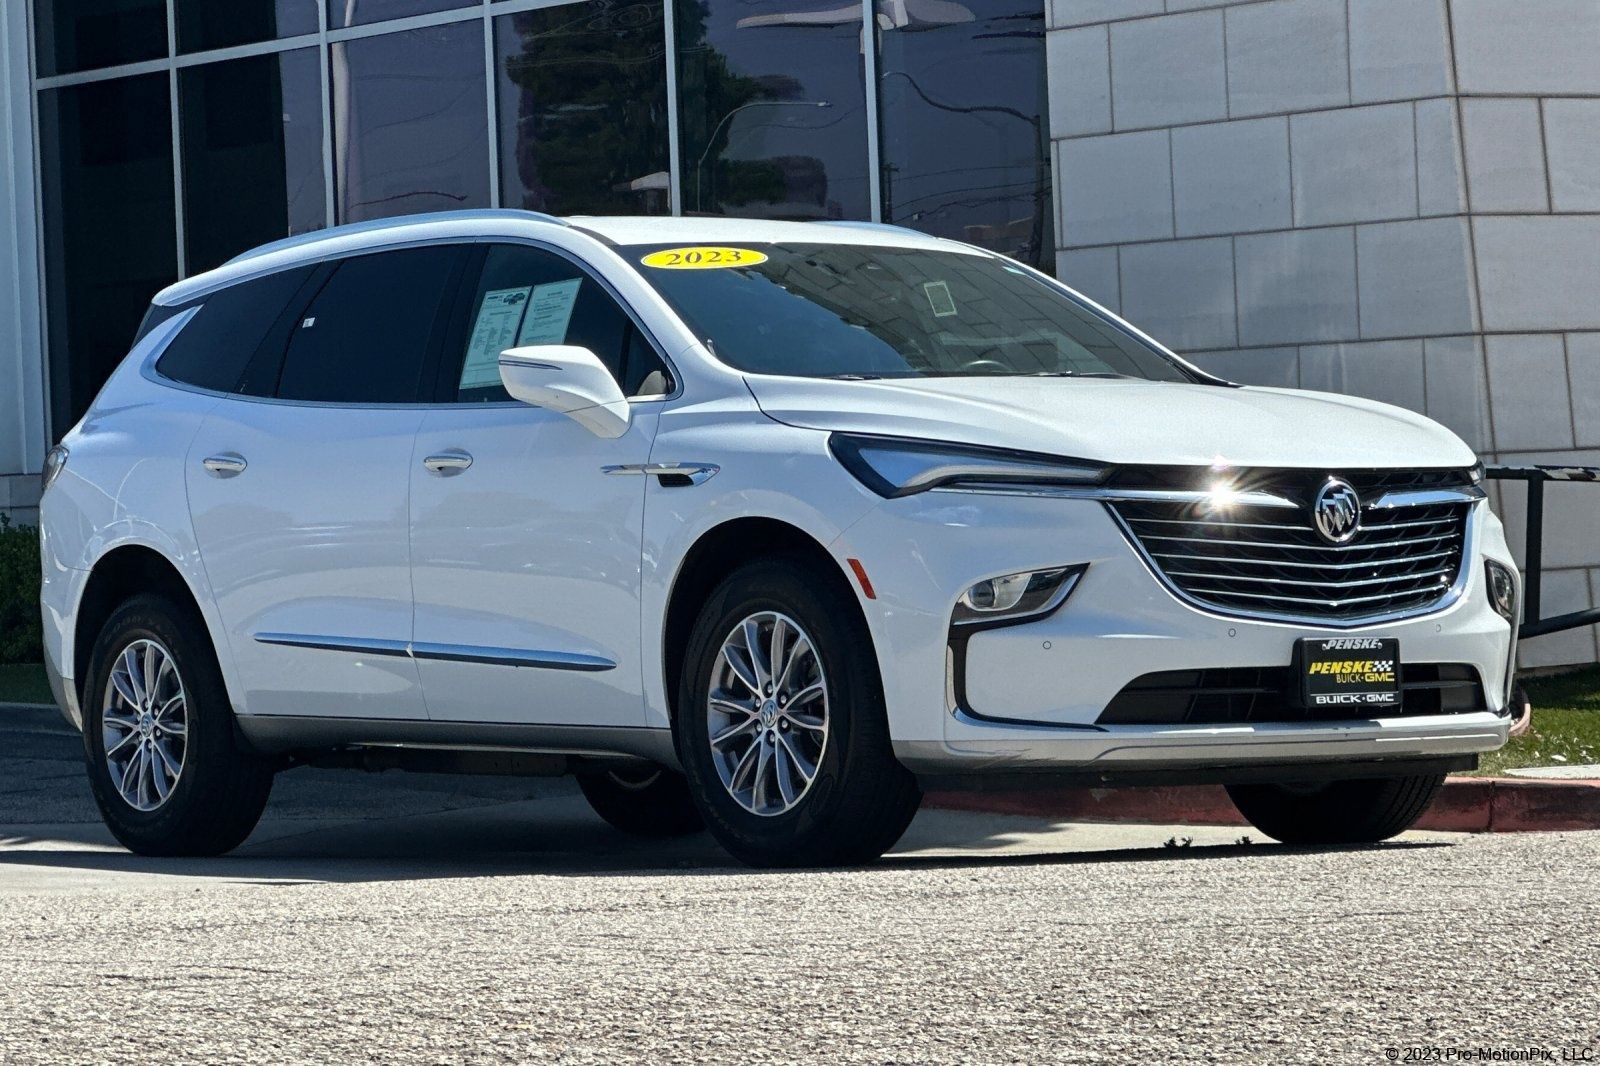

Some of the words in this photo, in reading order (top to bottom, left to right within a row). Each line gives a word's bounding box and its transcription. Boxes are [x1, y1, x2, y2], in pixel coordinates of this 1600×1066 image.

[665, 250, 742, 266] 2023
[1325, 639, 1379, 650] PENSKE
[1308, 660, 1374, 674] PENSKE
